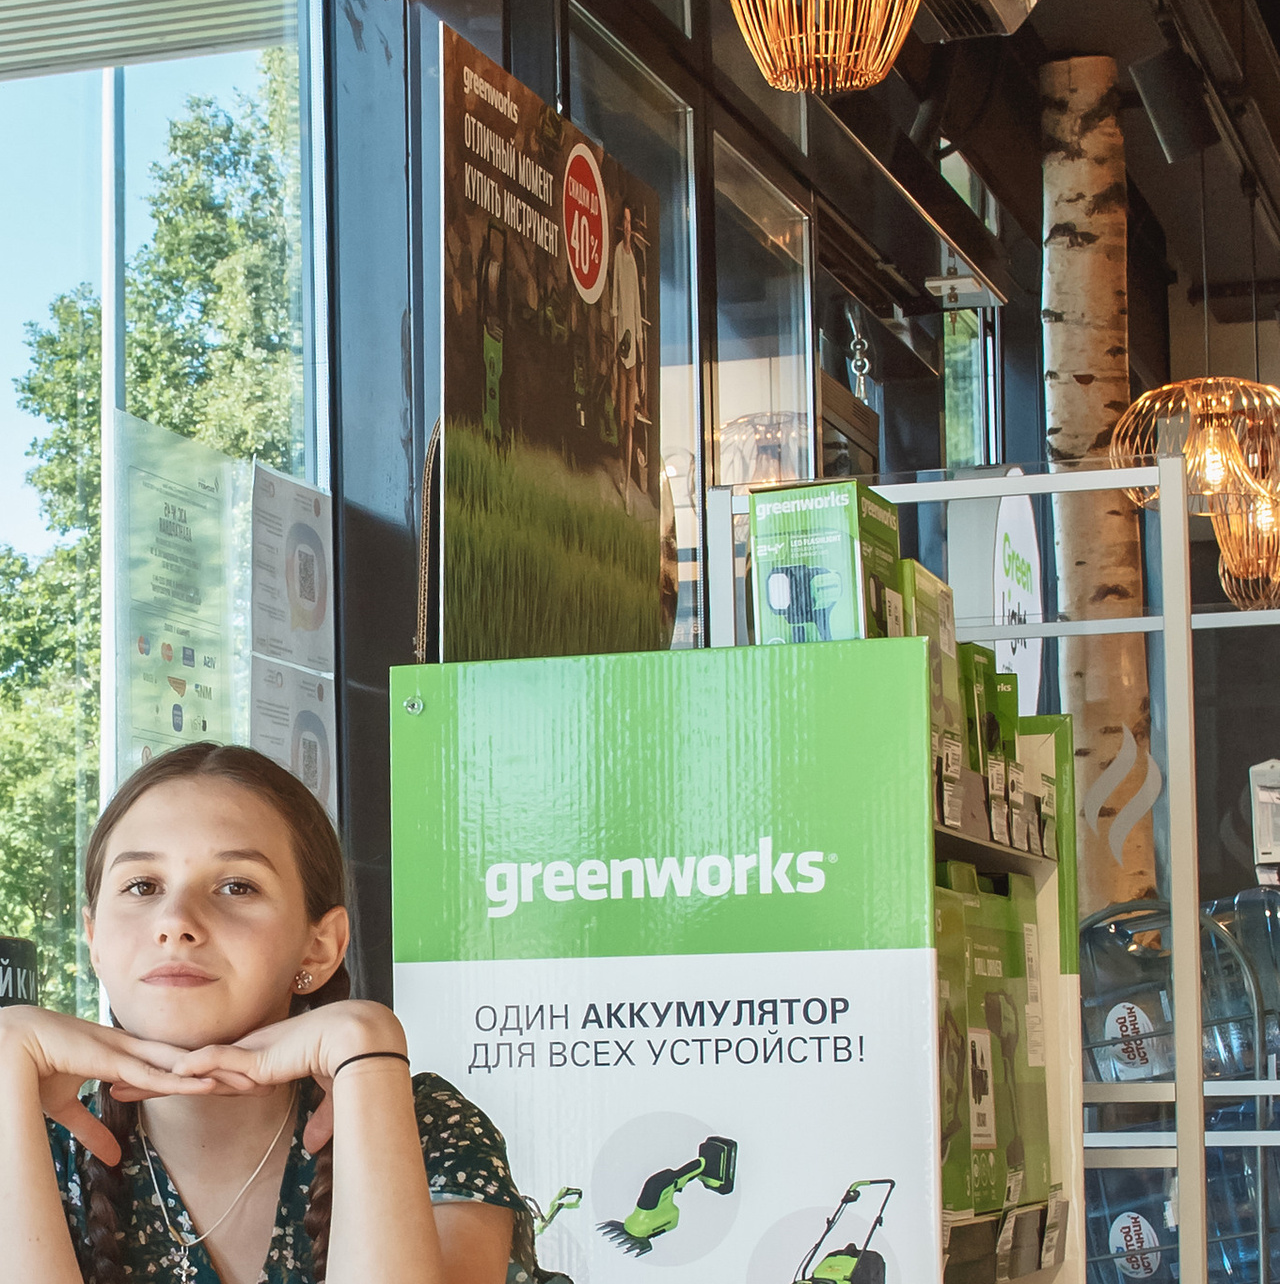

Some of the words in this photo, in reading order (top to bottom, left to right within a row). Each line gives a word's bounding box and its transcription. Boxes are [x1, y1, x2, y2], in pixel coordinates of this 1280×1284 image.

[463, 66, 518, 124] greenworks
[464, 112, 516, 181] ОТЛИЧНЫЙ
[518, 151, 553, 207] МОМЕНТ
[464, 162, 501, 219] КУПИТЬ
[503, 189, 559, 258] ИНСТРУМЕНТ
[568, 175, 590, 210] СКИДКИ
[755, 491, 850, 521] greenworks
[1002, 532, 1033, 595] Green
[485, 837, 826, 918] greenworks
[475, 1003, 570, 1037] ОДИН
[581, 997, 850, 1030] АККУМУЛЯТОР
[468, 1041, 536, 1074] ДЛЯ
[549, 1039, 636, 1068] ВСЕХ
[647, 1030, 866, 1068] УСТРОЙСТВ!
[1119, 1226, 1141, 1270] СВТОЙ
[1130, 1216, 1153, 1274] ИСТЧНИК
